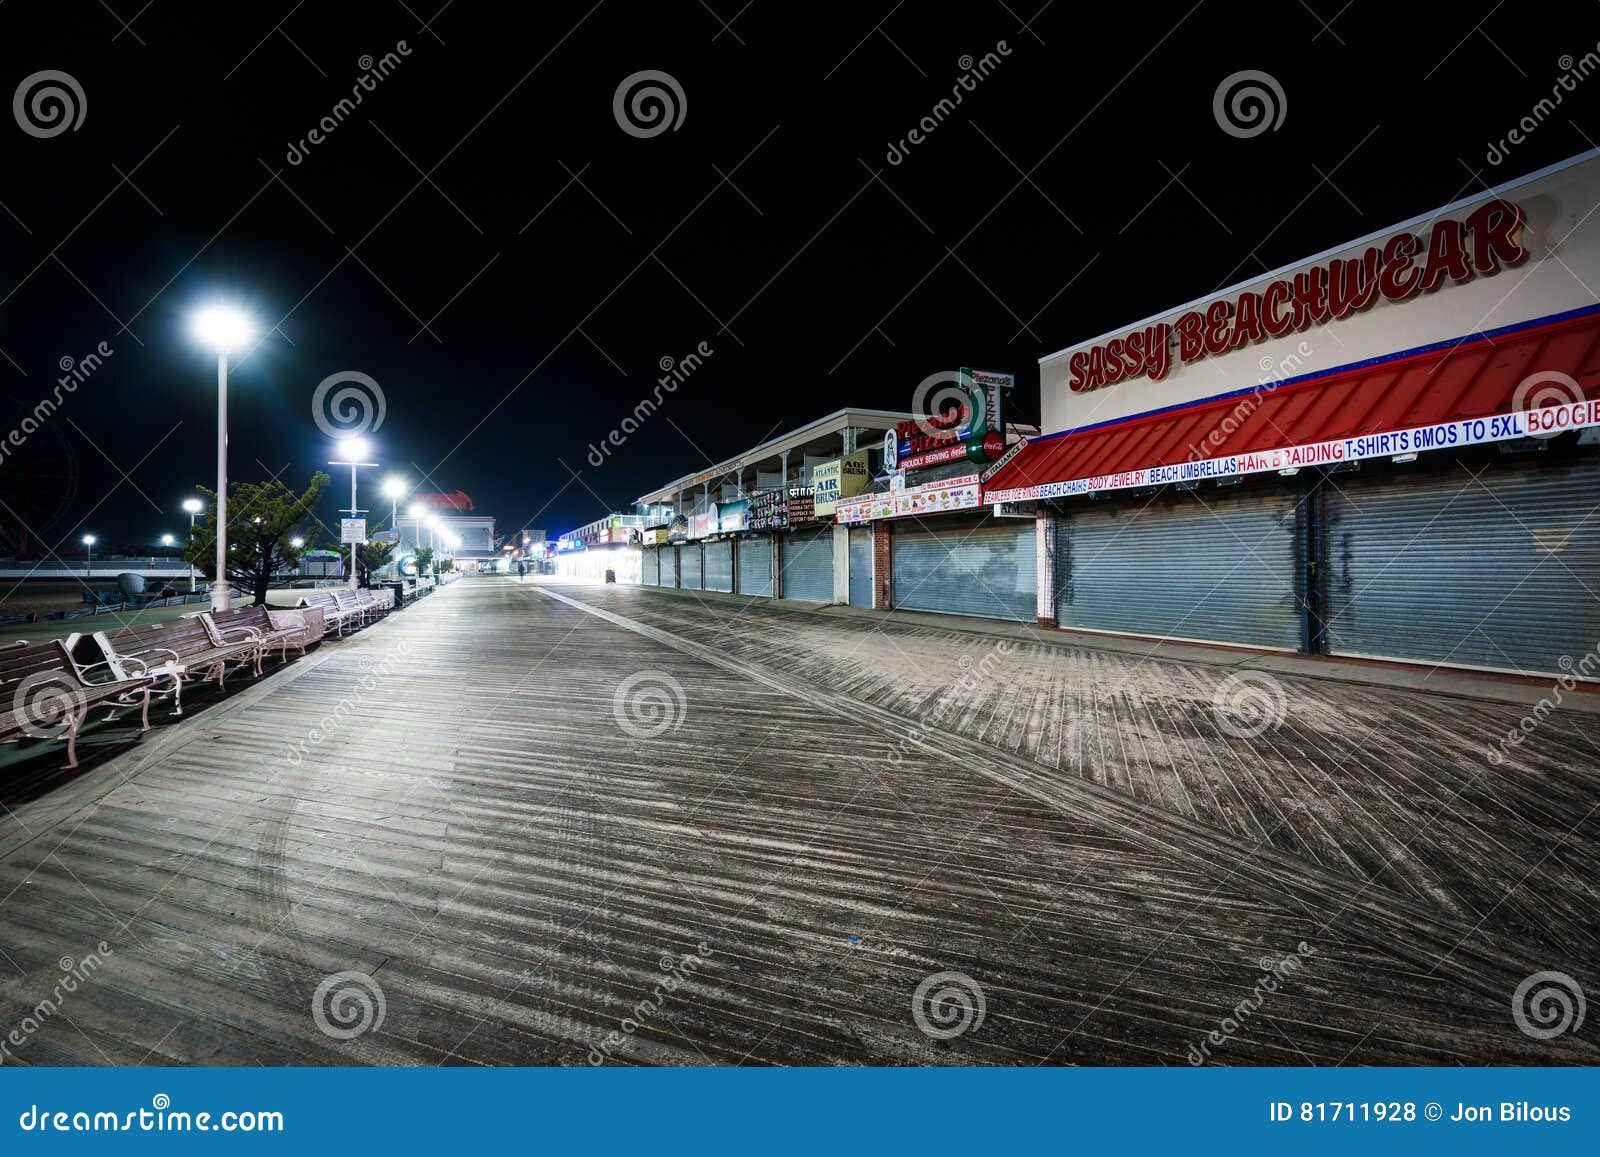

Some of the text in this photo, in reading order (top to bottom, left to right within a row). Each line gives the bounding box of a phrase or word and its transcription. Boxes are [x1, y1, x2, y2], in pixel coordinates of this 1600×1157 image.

[1069, 199, 1529, 393] SASSY BEACHWEAR
[1528, 401, 1600, 432] BOOGIE
[1345, 415, 1523, 457] T-SHIRTS 6MOS TO 5XL
[902, 458, 923, 469] PROUDLY
[925, 451, 949, 464] SERVING
[990, 453, 1012, 475] ITALIAN
[1238, 455, 1268, 471] HAIR
[815, 465, 839, 478] ATLANTIC
[843, 467, 866, 475] BRUSH
[1150, 457, 1237, 483] BEACH UMBRELLAS
[817, 479, 838, 491] AIR
[1040, 480, 1087, 497] BEACH CHAIRS
[1088, 471, 1146, 490] BODY JEWELRY
[816, 490, 840, 504] BRUSH
[984, 489, 1011, 502] SEAMLESS
[1012, 487, 1022, 499] TOE
[1023, 486, 1039, 498] RINGS
